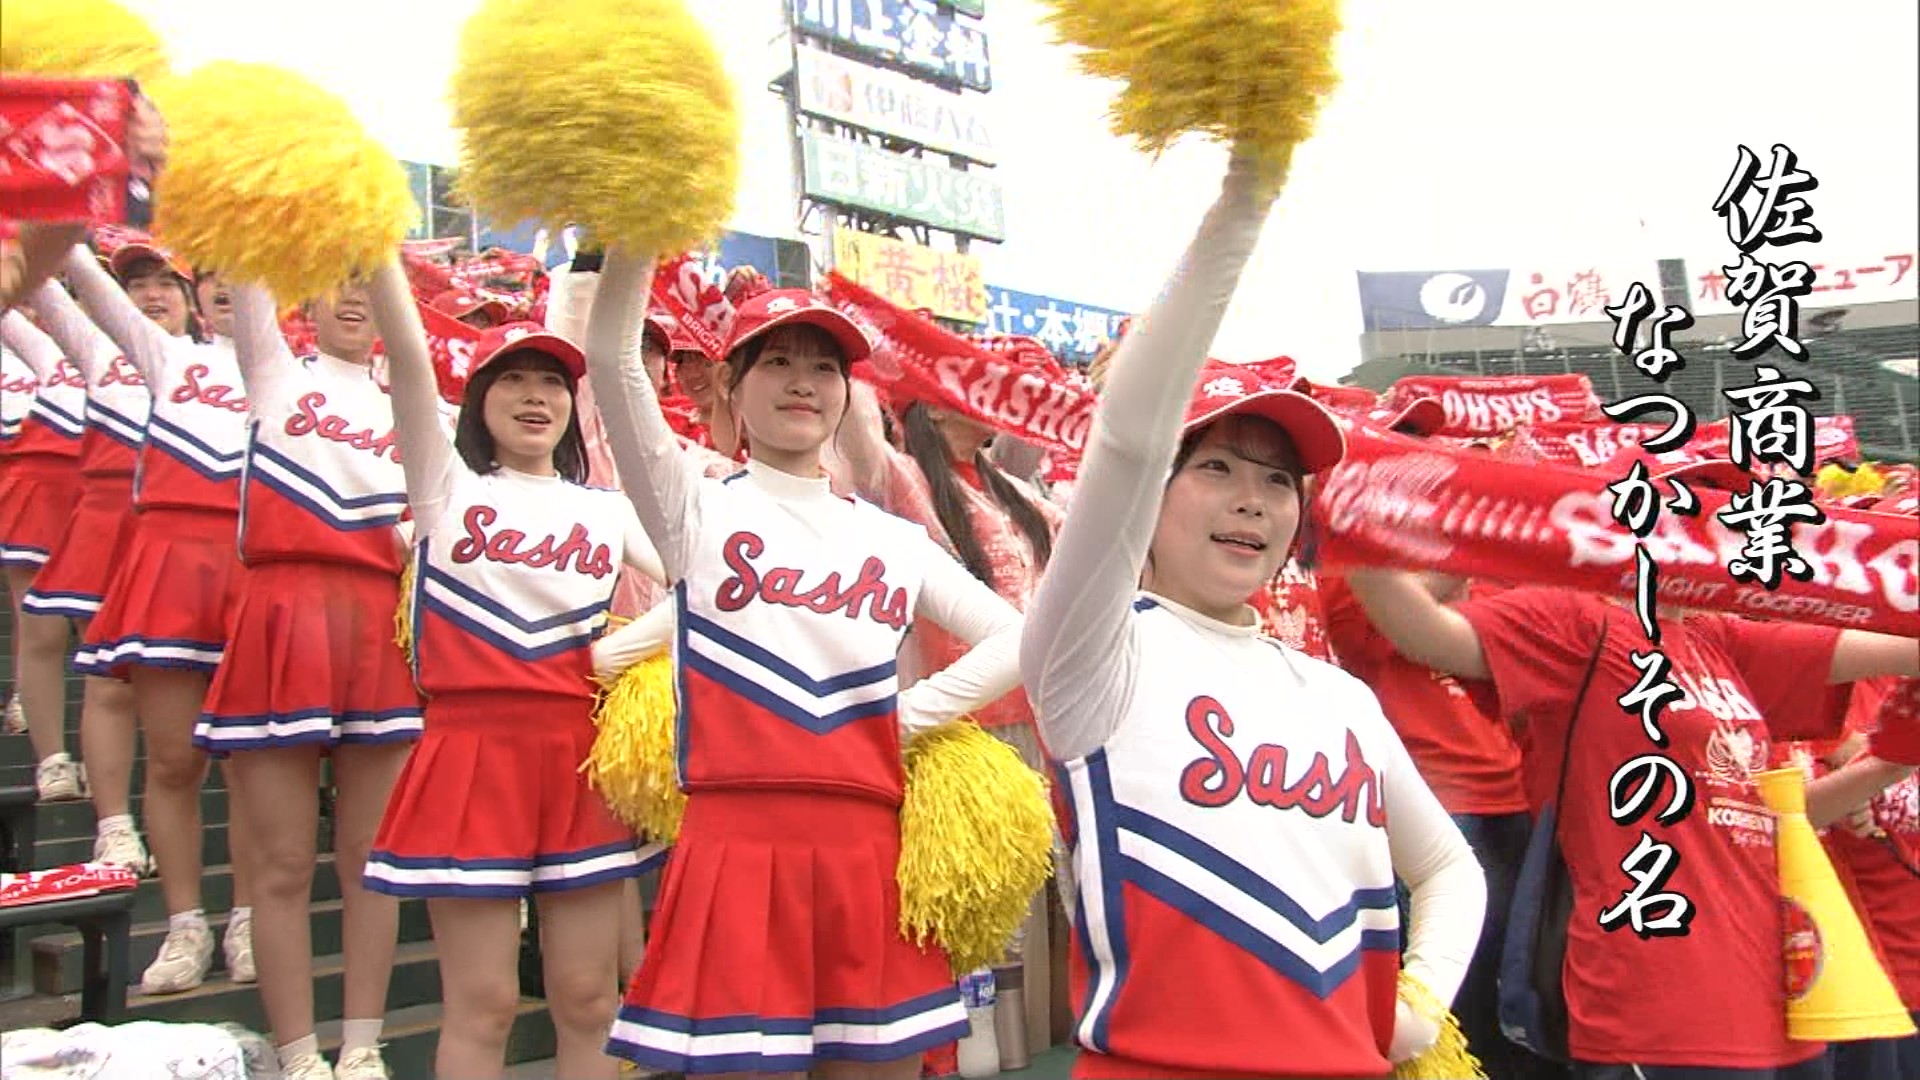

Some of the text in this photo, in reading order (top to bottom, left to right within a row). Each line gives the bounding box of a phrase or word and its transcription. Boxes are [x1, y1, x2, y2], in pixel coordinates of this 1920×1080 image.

[1697, 253, 1914, 302] ホニューア
[451, 505, 613, 580] Sasho
[715, 531, 908, 631] Sasho
[1735, 587, 1873, 625] TOGETHER
[1179, 695, 1387, 828] Sash
